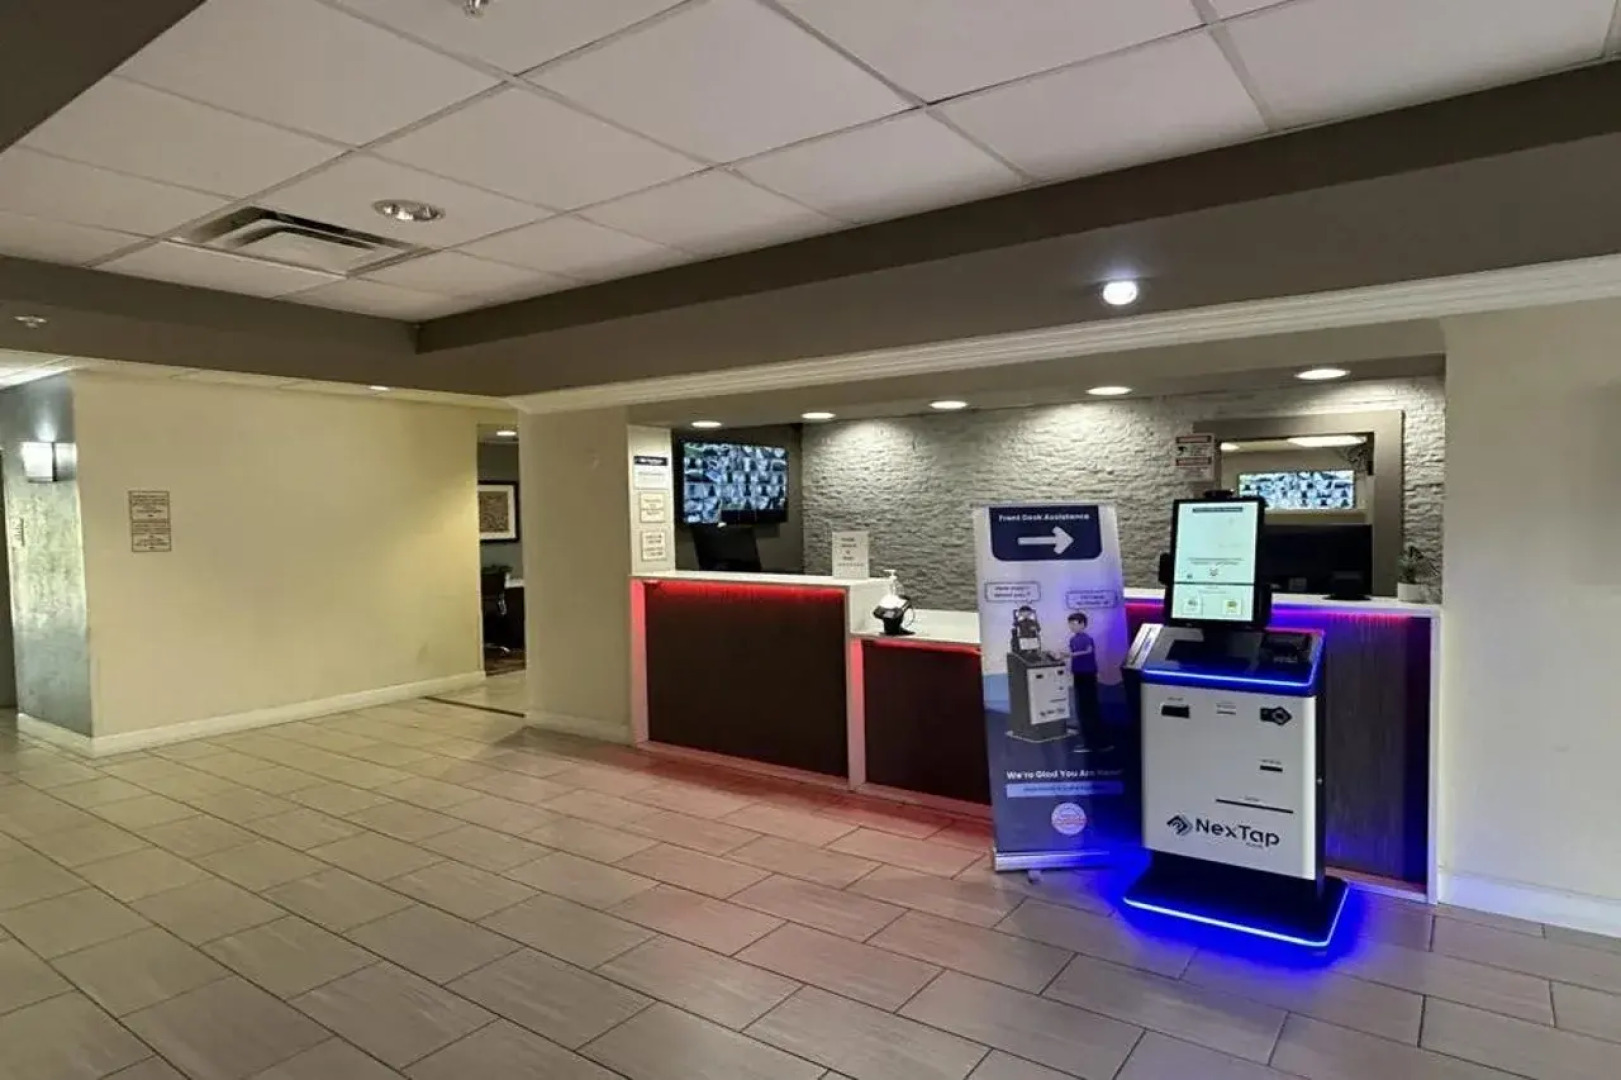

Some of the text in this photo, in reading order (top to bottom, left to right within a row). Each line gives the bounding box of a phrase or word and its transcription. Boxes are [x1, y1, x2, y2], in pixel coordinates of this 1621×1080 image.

[1044, 513, 1090, 521] Assistance
[1036, 770, 1058, 778] Glad
[1059, 769, 1077, 777] You
[1195, 818, 1280, 847] NexTap
